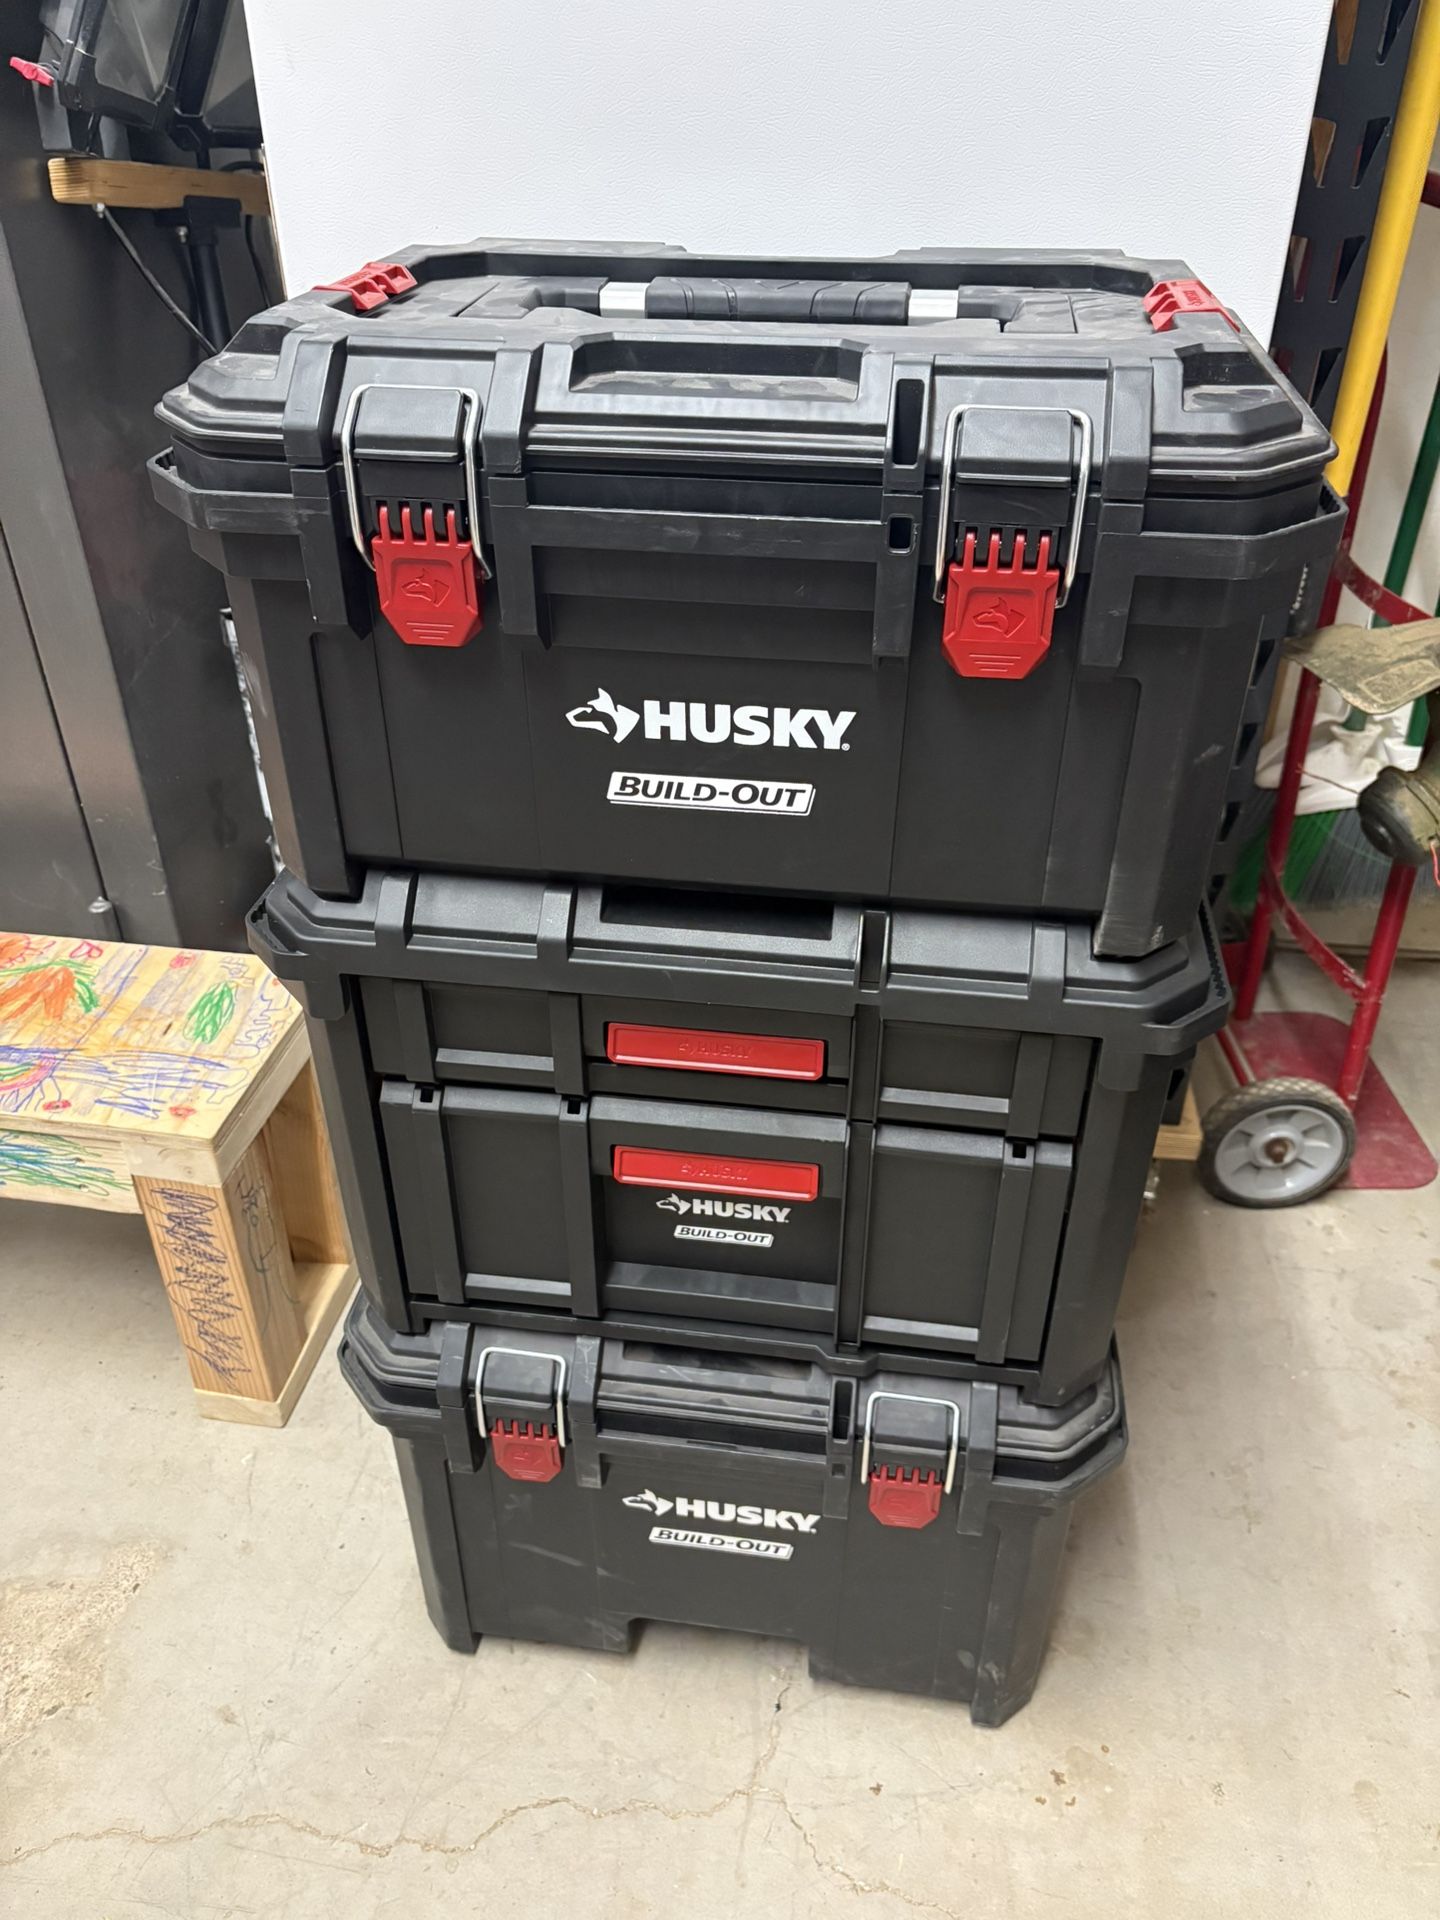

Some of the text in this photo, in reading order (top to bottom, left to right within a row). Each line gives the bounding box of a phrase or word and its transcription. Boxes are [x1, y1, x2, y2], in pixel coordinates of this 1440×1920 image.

[643, 700, 857, 750] HUSKY
[614, 776, 806, 807] BUILD-OUT
[692, 1199, 791, 1223] HUSKY
[677, 1227, 769, 1243] BUILD-OUT
[676, 1497, 821, 1534] HUSKY
[654, 1529, 787, 1555] BUILD-OUT
